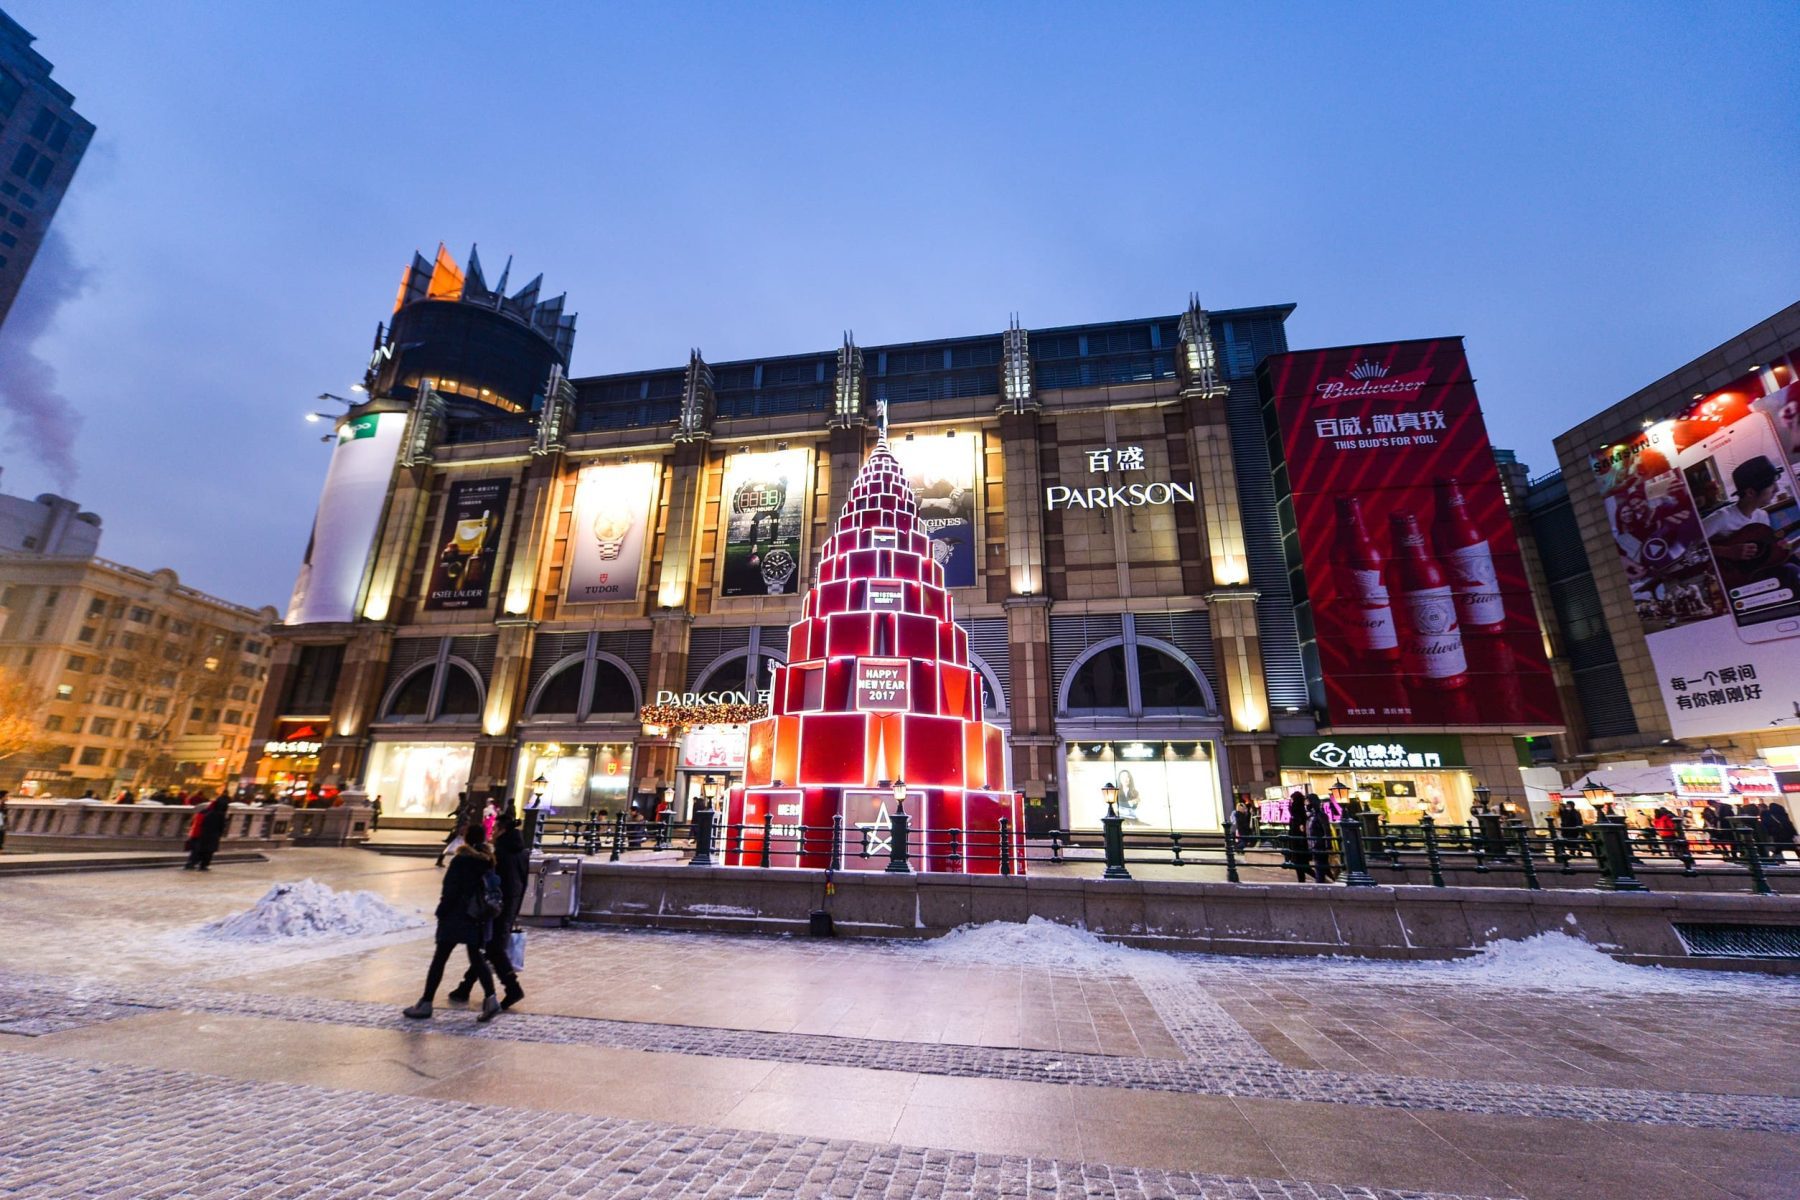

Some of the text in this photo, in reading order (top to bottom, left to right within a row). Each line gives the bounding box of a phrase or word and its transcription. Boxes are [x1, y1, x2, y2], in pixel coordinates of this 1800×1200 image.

[1316, 380, 1427, 399] Budweiser
[1333, 434, 1438, 450] THIS BUD'S FOR YOU.
[1085, 446, 1146, 473] 百盛
[1593, 434, 1660, 472] SAMSUNG
[1046, 481, 1195, 511] PARKSON
[585, 584, 619, 594] TUDOR
[865, 669, 898, 679] HAPPY
[1670, 664, 1757, 691] 每一个瞬间
[859, 679, 878, 689] NEW
[656, 690, 751, 707] PARKSON
[868, 690, 896, 701] 2017
[1676, 683, 1763, 710] 有你刚刚好
